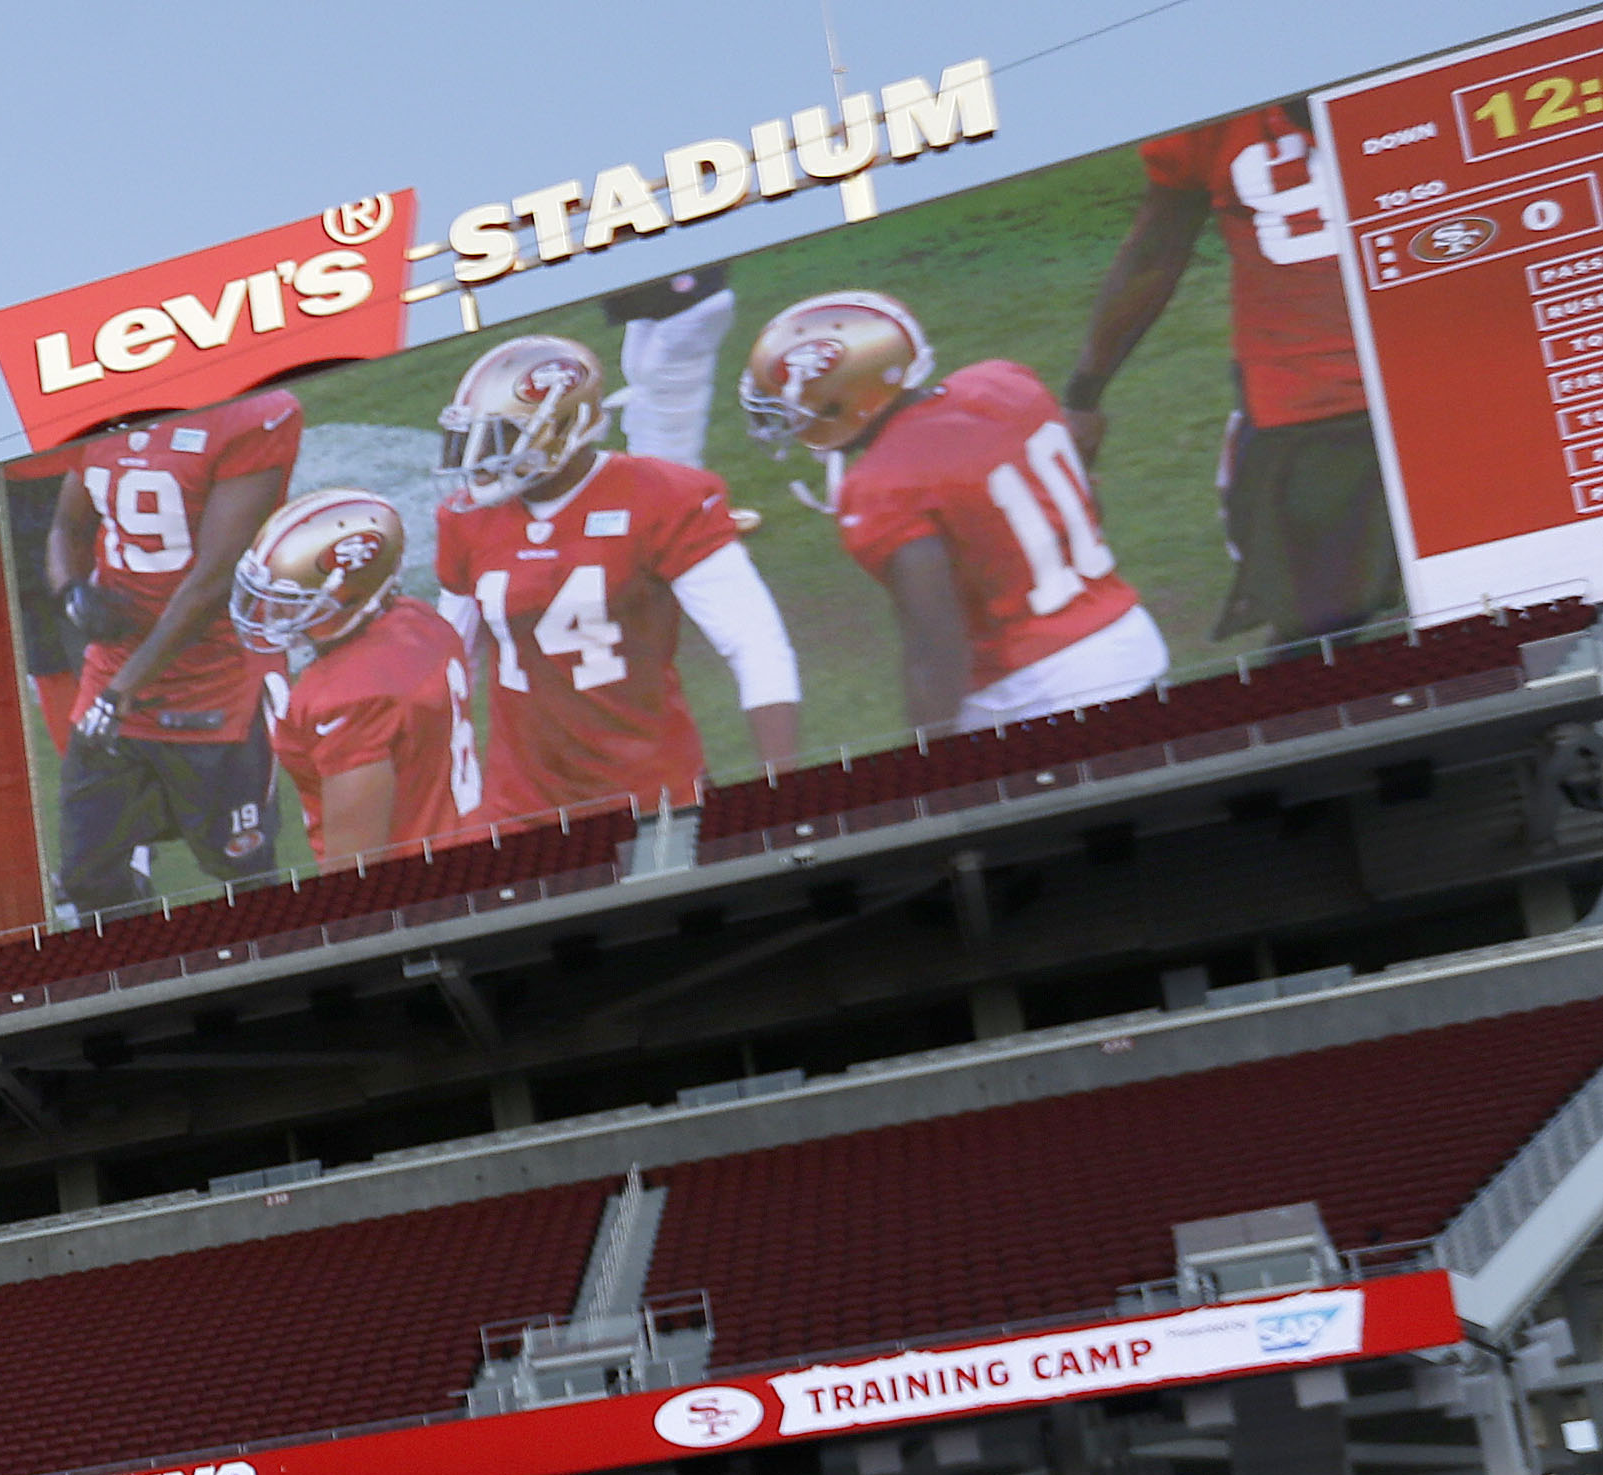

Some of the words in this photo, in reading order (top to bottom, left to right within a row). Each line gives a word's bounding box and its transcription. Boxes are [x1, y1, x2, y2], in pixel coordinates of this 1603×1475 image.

[449, 58, 999, 282] STADIUM
[1362, 121, 1439, 155] DOWN
[1374, 190, 1409, 209] TO
[1410, 180, 1447, 200] GO
[84, 466, 192, 573] 19
[987, 422, 1116, 616] 10
[474, 564, 628, 693] 14
[230, 802, 260, 835] 19
[805, 1361, 1011, 1414] TRAINING
[1032, 1338, 1152, 1379] CAMP
